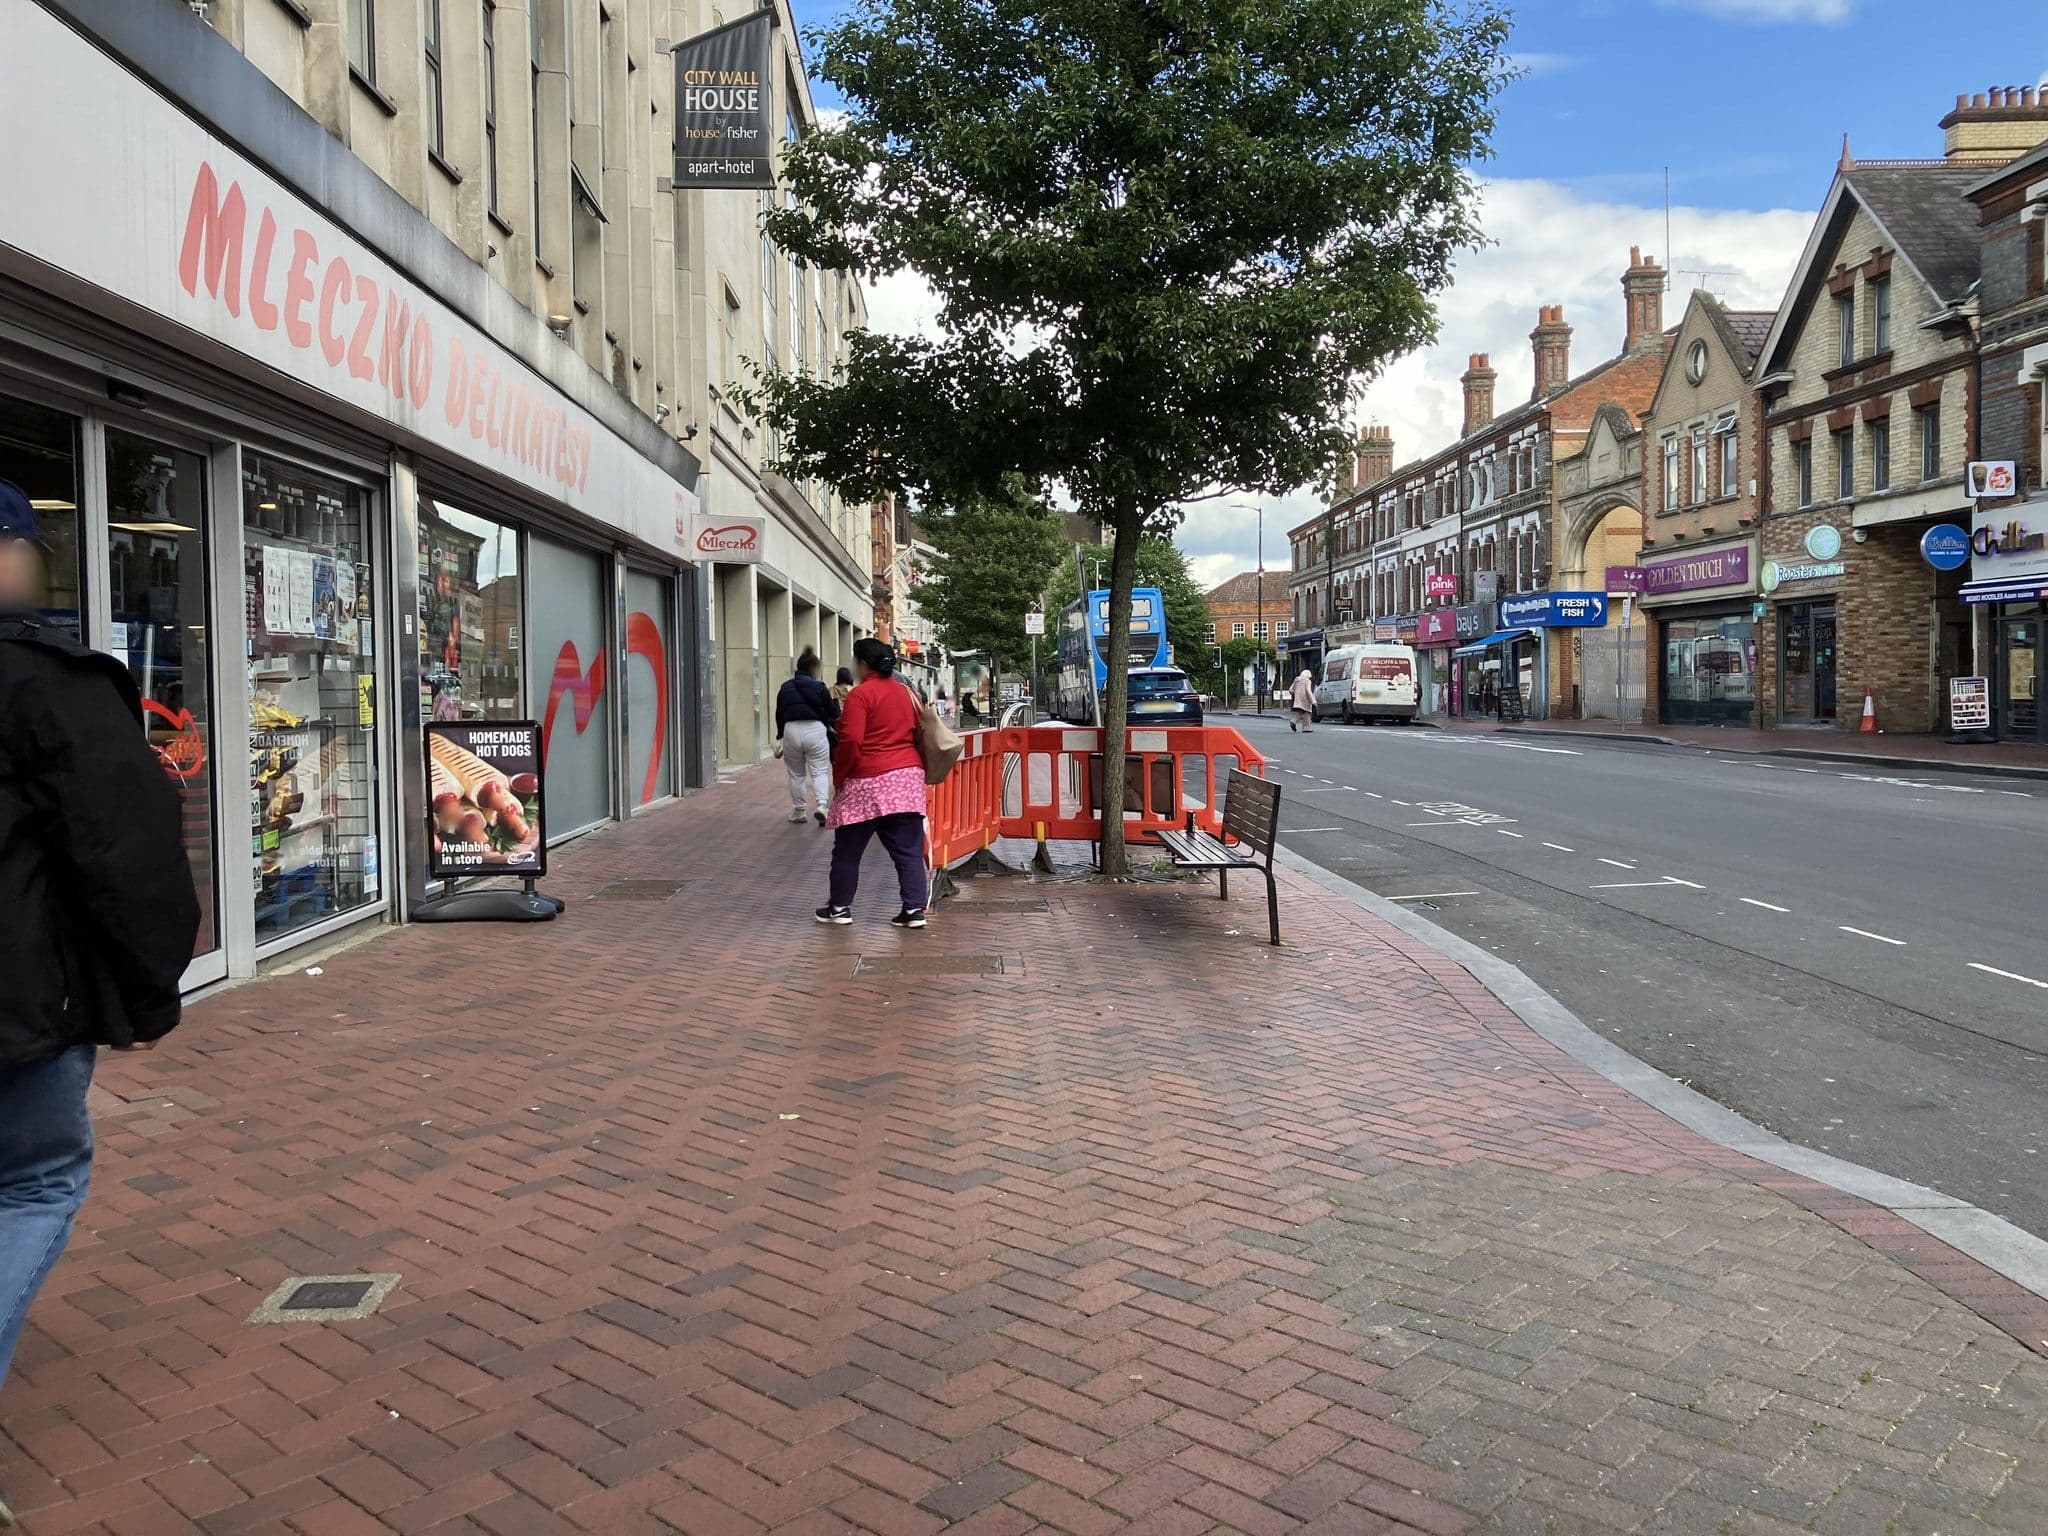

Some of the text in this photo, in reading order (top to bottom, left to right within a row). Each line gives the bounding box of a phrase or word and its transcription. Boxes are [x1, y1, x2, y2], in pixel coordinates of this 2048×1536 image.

[684, 70, 759, 86] CITY WALL
[685, 89, 759, 111] HOUSE
[715, 116, 727, 127] by
[685, 126, 720, 139] house
[727, 126, 758, 139] fisher
[688, 159, 755, 176] apart-hotel
[178, 160, 592, 497] MLECZKO DELIKATESY
[702, 536, 756, 550] Mleczko
[1648, 558, 1722, 587] GOLDEN TOUCH
[1431, 576, 1454, 591] pink
[1556, 598, 1590, 607] FRESH
[1561, 608, 1585, 617] FISH
[1456, 609, 1479, 636] bay's
[469, 731, 531, 744] HOMEMADE
[476, 745, 531, 757] HOT DOGS
[441, 841, 491, 853] Available
[441, 854, 483, 865] in store
